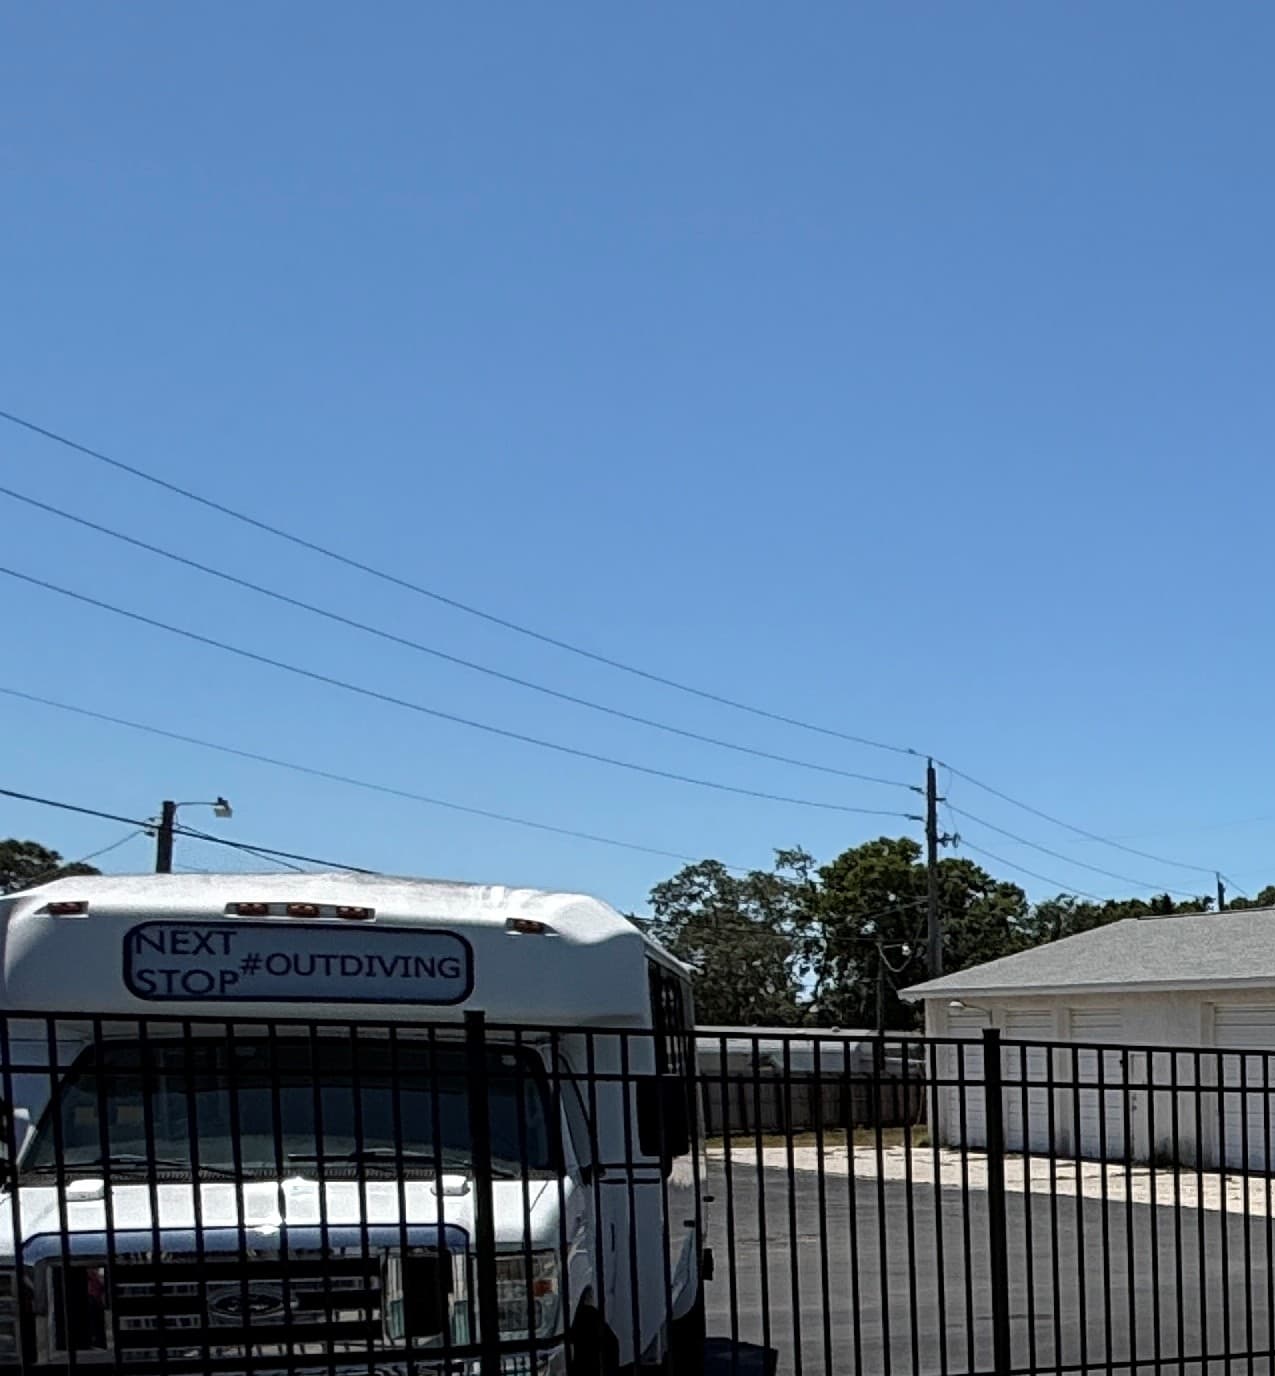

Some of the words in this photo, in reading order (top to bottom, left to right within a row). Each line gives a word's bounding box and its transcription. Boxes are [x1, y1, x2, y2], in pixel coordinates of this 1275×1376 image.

[135, 930, 238, 956] NEXT
[239, 952, 461, 979] #OUTDIVING
[136, 969, 241, 995] STOP
